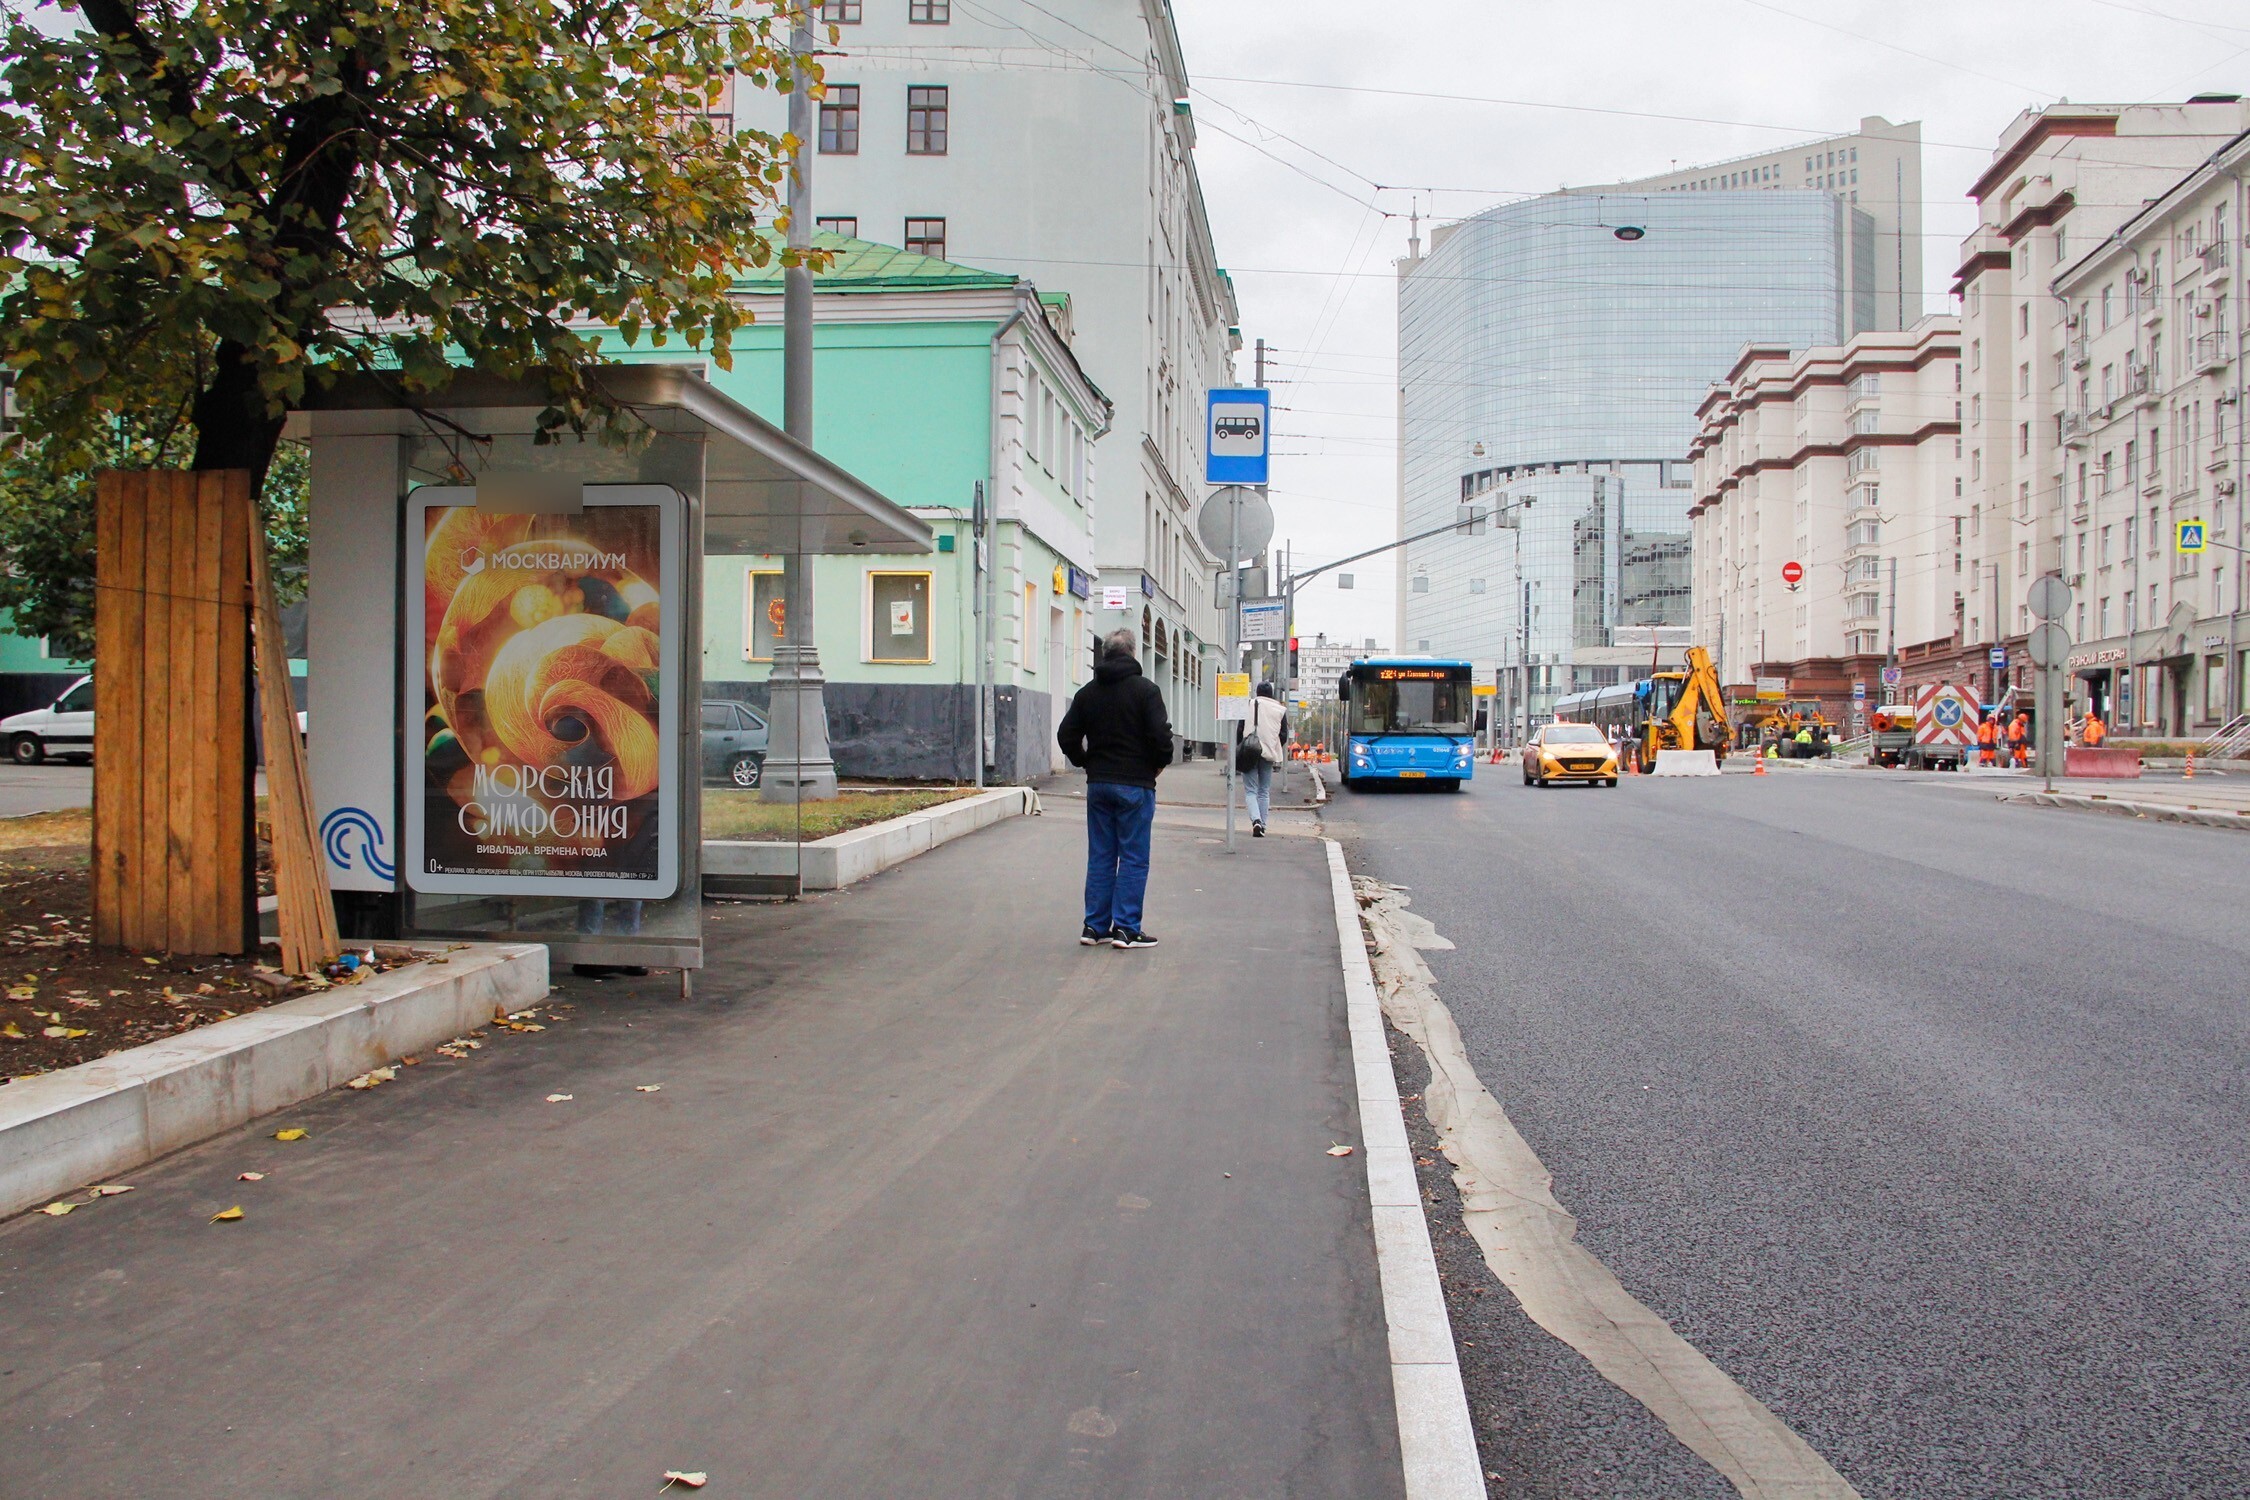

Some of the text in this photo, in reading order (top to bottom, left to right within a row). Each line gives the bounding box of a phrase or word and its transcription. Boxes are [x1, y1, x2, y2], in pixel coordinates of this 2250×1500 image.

[492, 552, 626, 570] МОСКВАРИУМ
[472, 764, 613, 800] МОРСКАЯ
[458, 802, 628, 839] СИМФОНИЯ
[476, 845, 608, 857] ВИВАЛЬДИ. ВРЕМЕНА ГОДА
[430, 858, 443, 873] 0+
